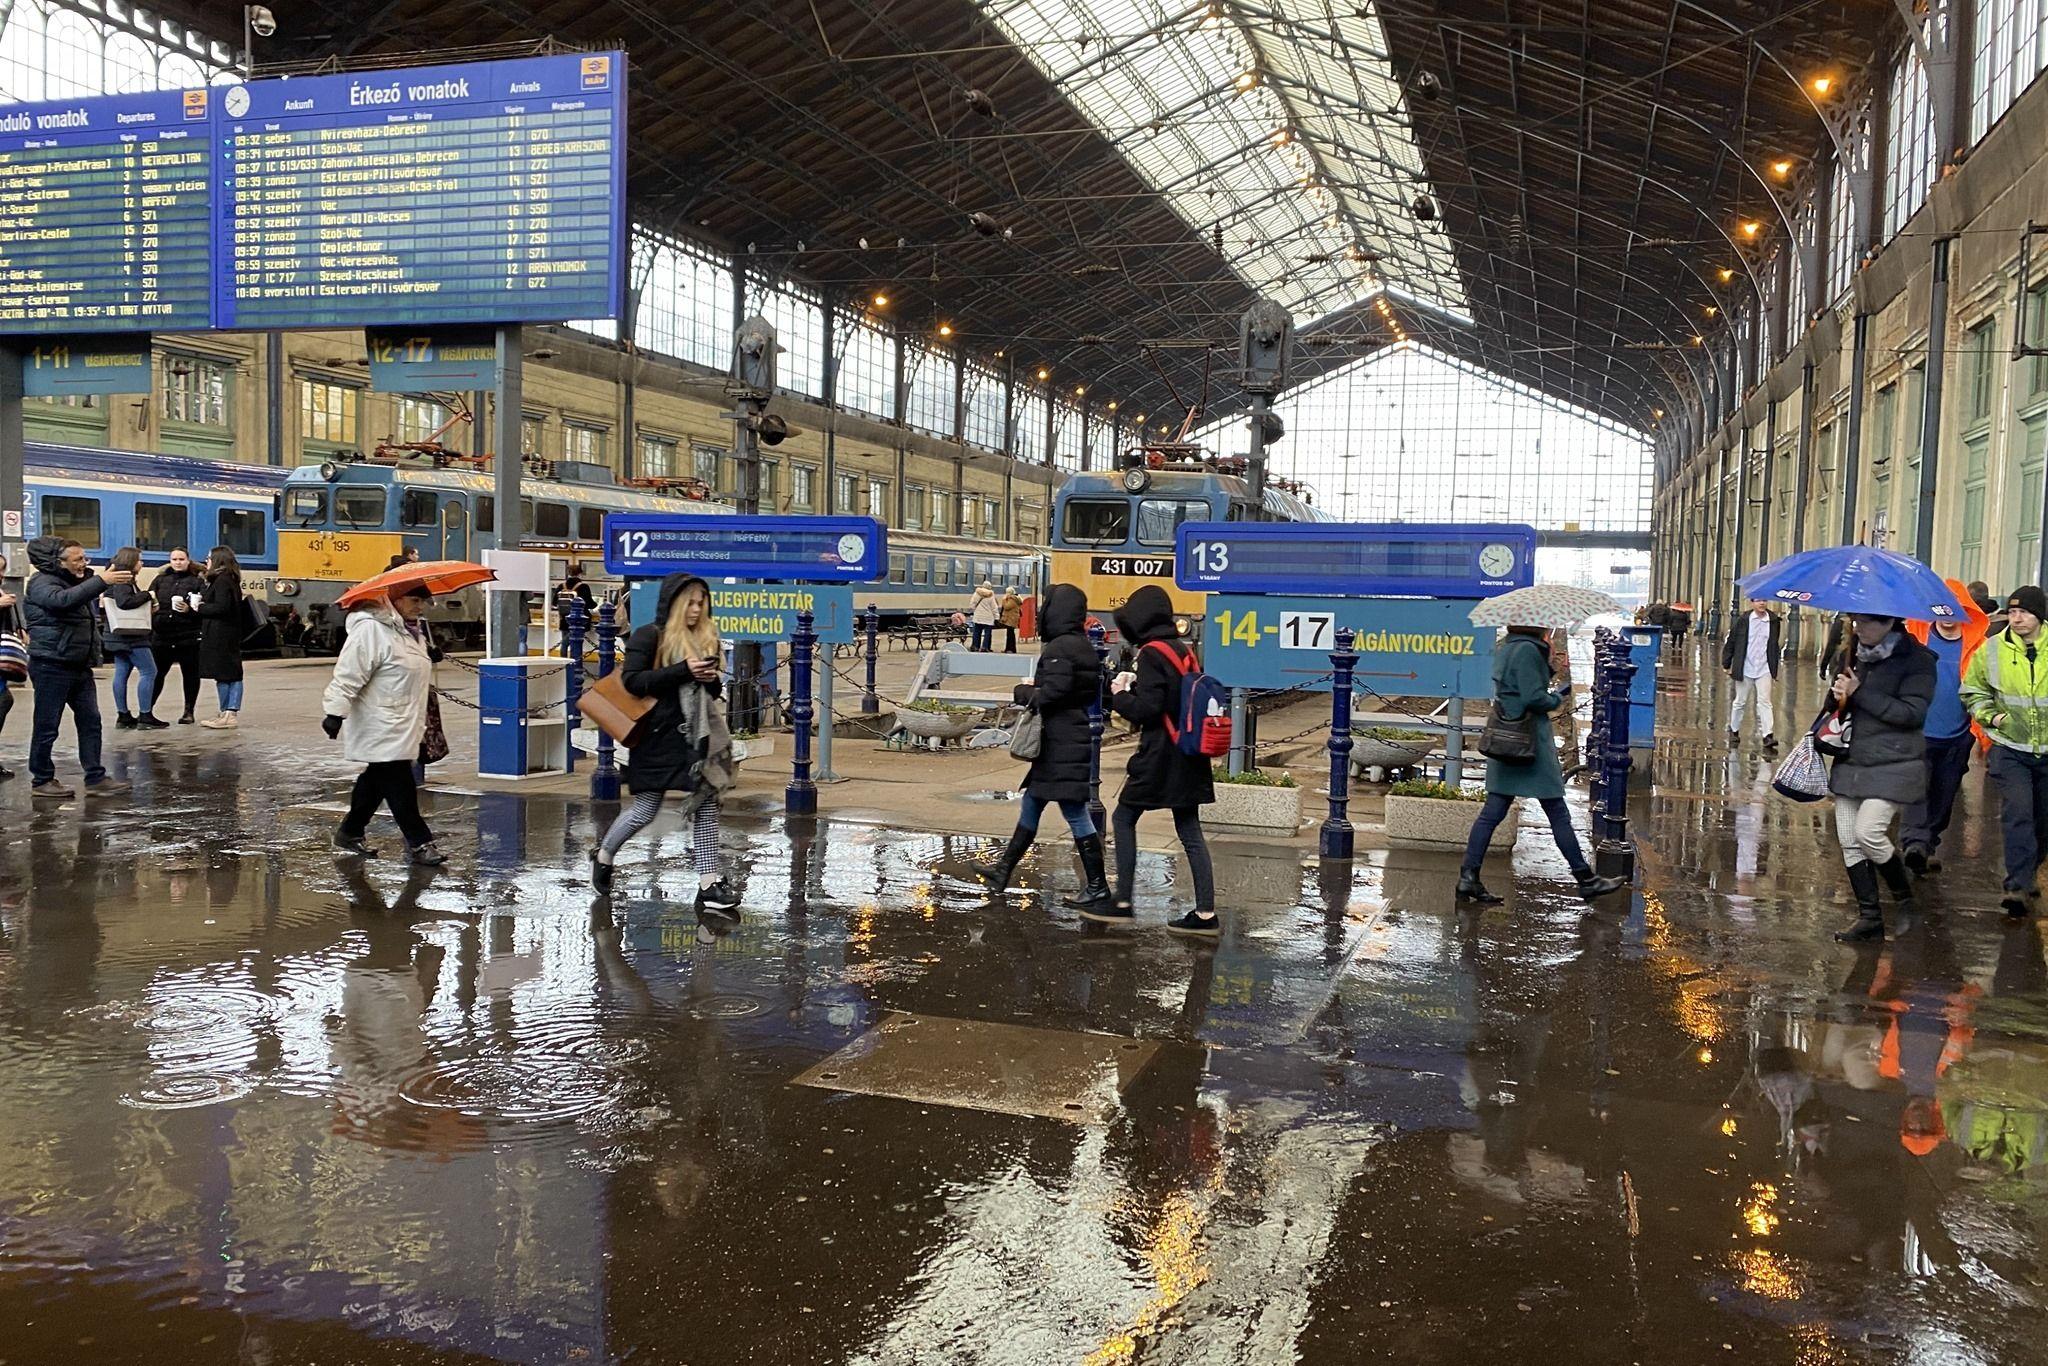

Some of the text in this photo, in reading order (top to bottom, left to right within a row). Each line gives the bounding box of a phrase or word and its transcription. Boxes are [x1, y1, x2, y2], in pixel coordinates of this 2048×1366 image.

[350, 78, 470, 106] Érkező vonatok
[510, 81, 541, 94] Arrivals
[285, 99, 314, 110] Ankunft
[37, 108, 89, 129] vonatok
[117, 113, 156, 124] Departures
[510, 115, 519, 127] 11
[124, 143, 134, 154] 17
[124, 156, 134, 168] 10
[266, 161, 276, 172] IC
[280, 158, 316, 171] 619/639
[510, 145, 520, 157] 13
[123, 170, 130, 181] 3
[510, 174, 520, 186] 14
[123, 184, 130, 194] 2
[513, 189, 520, 200] 4
[124, 197, 134, 208] 12
[123, 211, 130, 221] 6
[509, 204, 519, 216] 16
[124, 224, 135, 236] 15
[507, 219, 514, 230] 3
[123, 238, 130, 249] 5
[508, 233, 519, 245] 17
[236, 273, 260, 285] 10:07
[264, 272, 275, 284] IC
[279, 272, 296, 283] 717
[507, 263, 518, 275] 12
[236, 287, 260, 298] 10:09
[506, 277, 513, 289] 2
[22, 491, 32, 506] 2
[309, 539, 350, 552] 431 195
[618, 531, 648, 558] 12
[1192, 542, 1229, 572] 13
[1101, 559, 1163, 575] 431 007
[1351, 629, 1475, 655] ÁGÁNYOKHOZ
